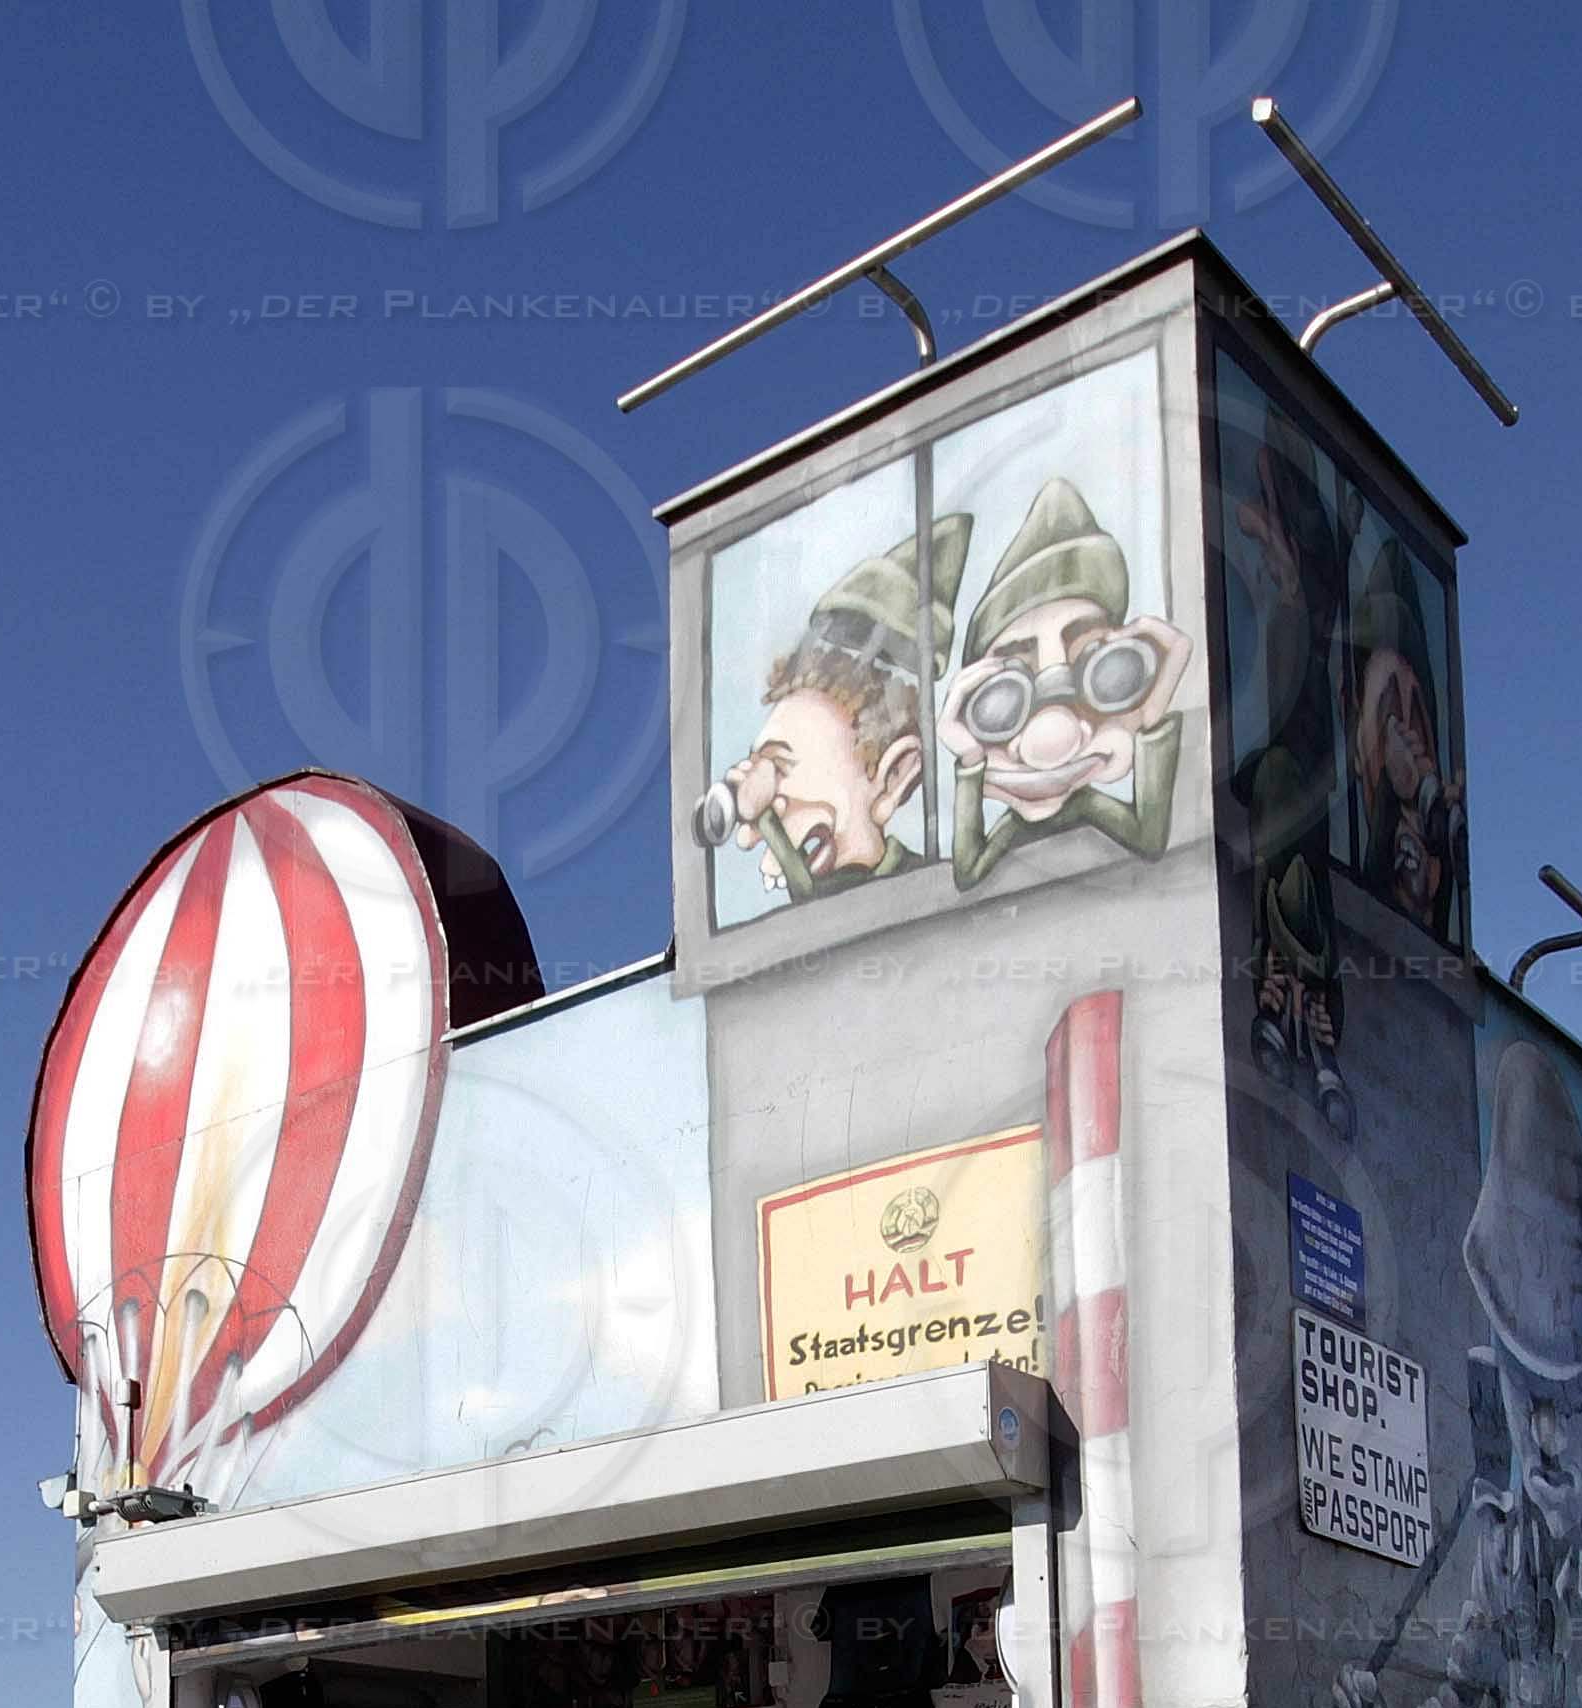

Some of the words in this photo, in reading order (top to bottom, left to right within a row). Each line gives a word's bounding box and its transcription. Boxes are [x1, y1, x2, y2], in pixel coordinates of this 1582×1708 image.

[845, 1248, 974, 1310] HALT
[789, 1294, 1046, 1366] Staatsgrenze!
[1298, 1316, 1419, 1403] TOURIST
[1301, 1359, 1386, 1429] SHOP.
[1301, 1423, 1345, 1480] WE
[1351, 1443, 1428, 1508] STAMP
[1312, 1483, 1431, 1558] PASSPORT
